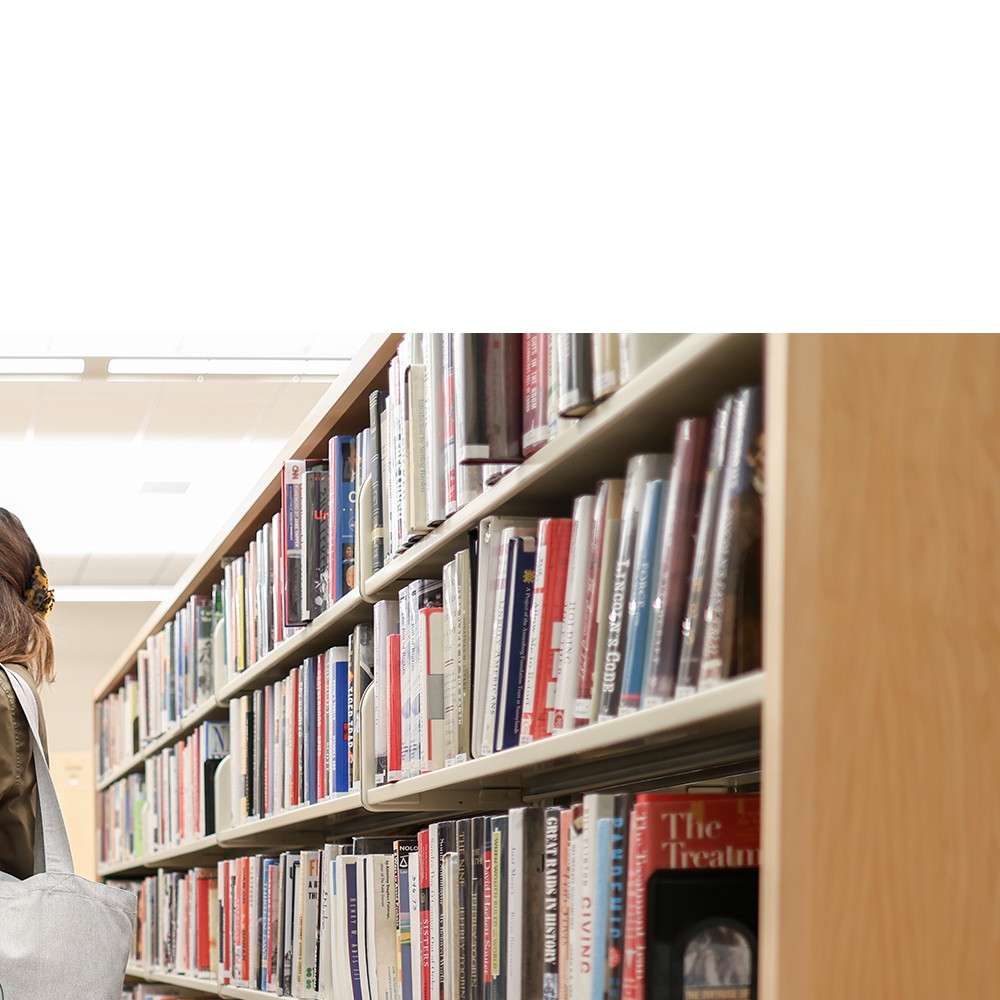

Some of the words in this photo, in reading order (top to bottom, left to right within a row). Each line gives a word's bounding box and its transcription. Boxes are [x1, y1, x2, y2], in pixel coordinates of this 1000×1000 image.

[531, 358, 538, 368] IN
[530, 602, 540, 630] Allow
[564, 602, 576, 665] HOLDING
[530, 638, 537, 652] Me
[490, 652, 502, 716] AMERICANS
[525, 674, 533, 706] Retort
[602, 652, 621, 693] CODE
[545, 816, 558, 856] GREAT
[636, 812, 648, 846] The
[661, 812, 722, 840] The
[544, 858, 558, 895] RAIDS
[609, 818, 624, 939] PANDEMIC
[545, 898, 556, 910] IN
[635, 850, 646, 942] Treatment
[544, 913, 556, 965] HISTORY
[581, 897, 591, 974] GIVING
[635, 946, 644, 980] Trap
